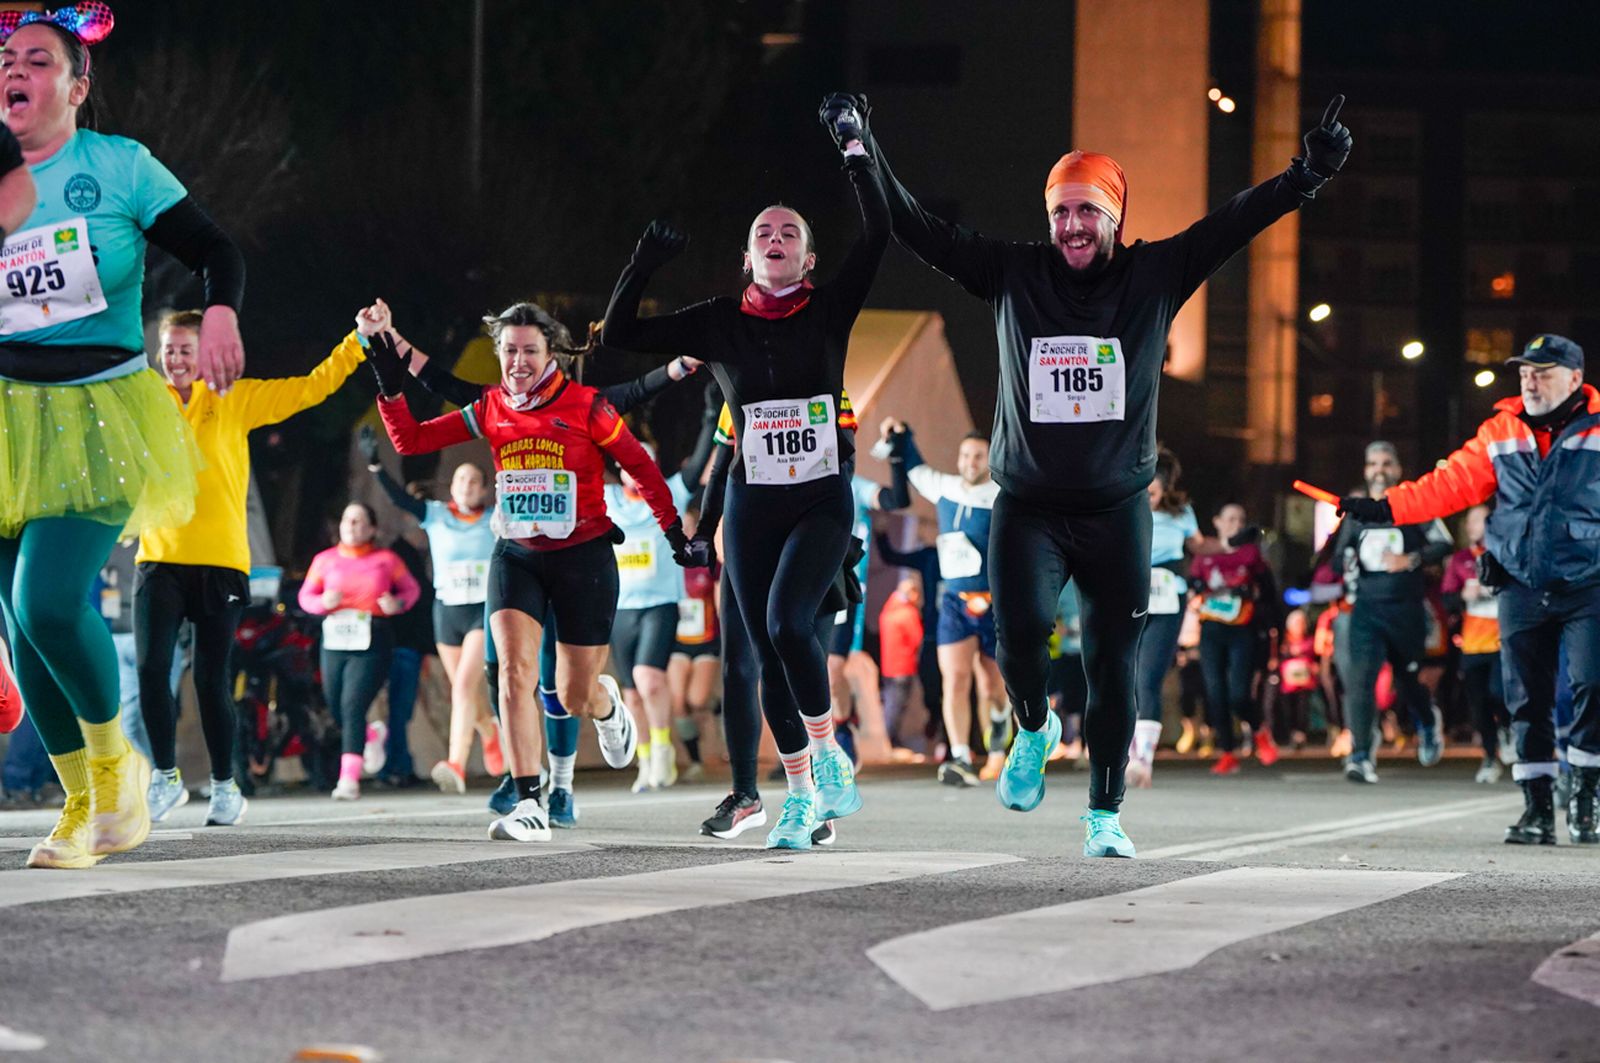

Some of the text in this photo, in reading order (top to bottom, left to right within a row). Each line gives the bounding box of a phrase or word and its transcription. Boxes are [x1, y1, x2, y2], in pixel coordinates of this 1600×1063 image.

[31, 239, 42, 249] DE
[6, 260, 65, 298] 925
[1050, 345, 1088, 355] NOCHE DE
[1039, 356, 1056, 366] SAN
[1050, 367, 1103, 392] 1185
[790, 407, 800, 417] DE
[752, 420, 769, 430] SAN
[762, 428, 817, 455] 1186
[514, 474, 537, 484] NOCHE
[538, 474, 547, 483] DE
[506, 485, 521, 493] SAN
[505, 493, 567, 515] 12096
